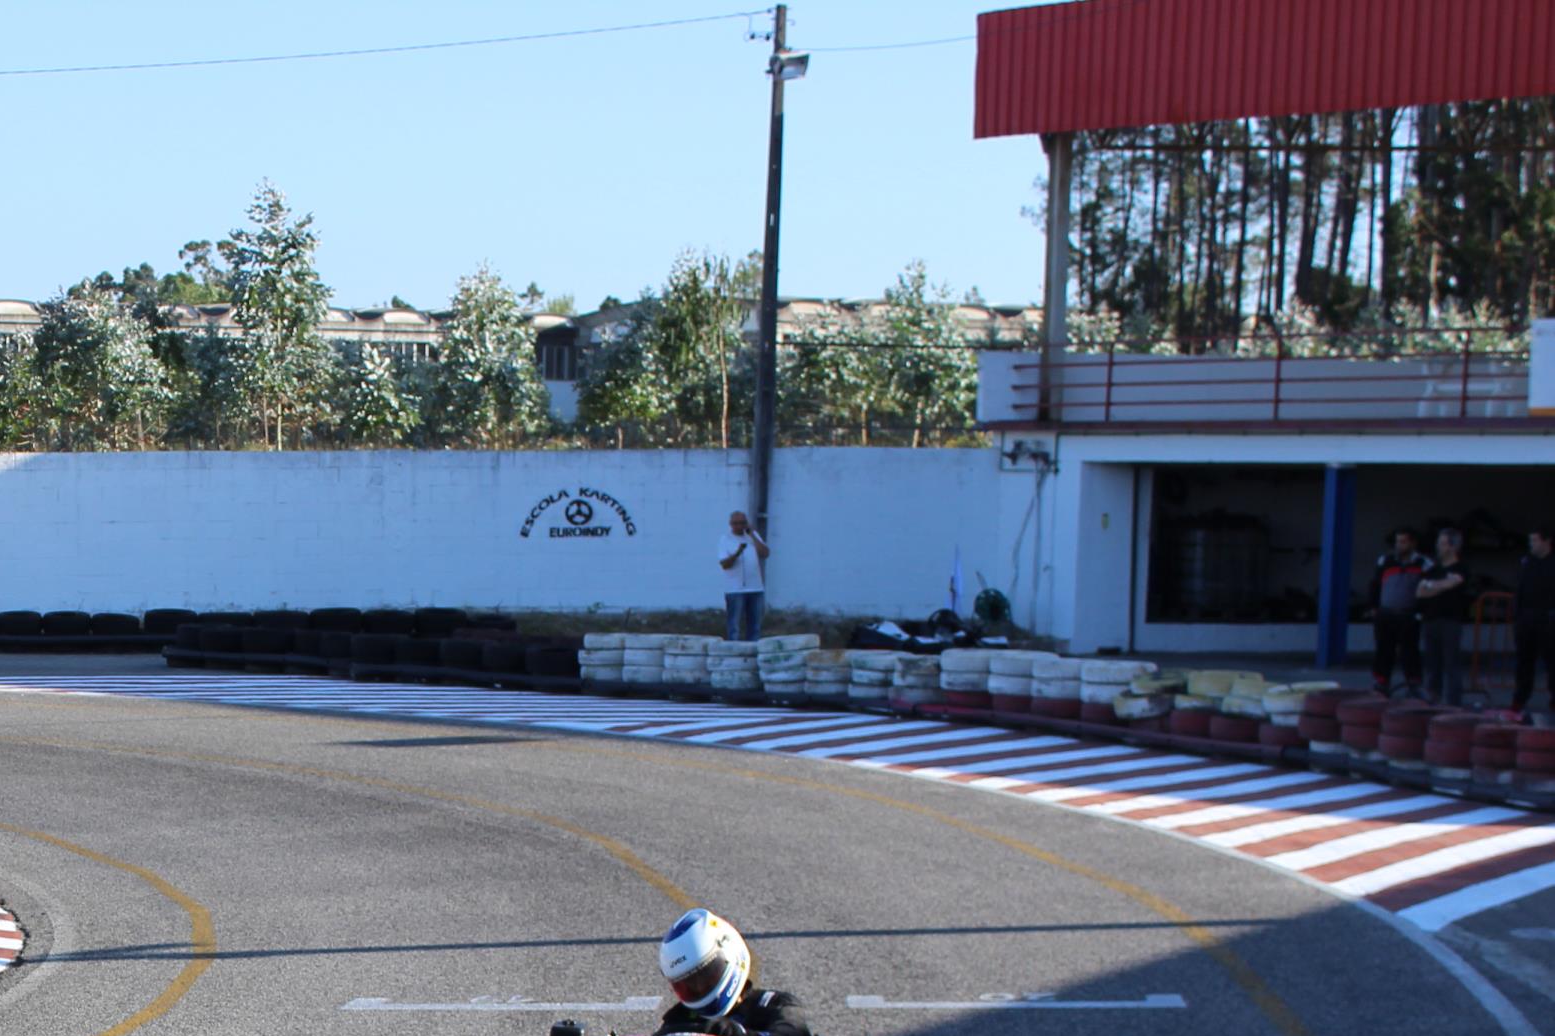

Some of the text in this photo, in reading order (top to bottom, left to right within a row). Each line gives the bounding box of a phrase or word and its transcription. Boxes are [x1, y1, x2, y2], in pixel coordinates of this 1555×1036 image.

[519, 487, 637, 538] ESCOLA KARTING
[549, 526, 611, 538] EUROINDY
